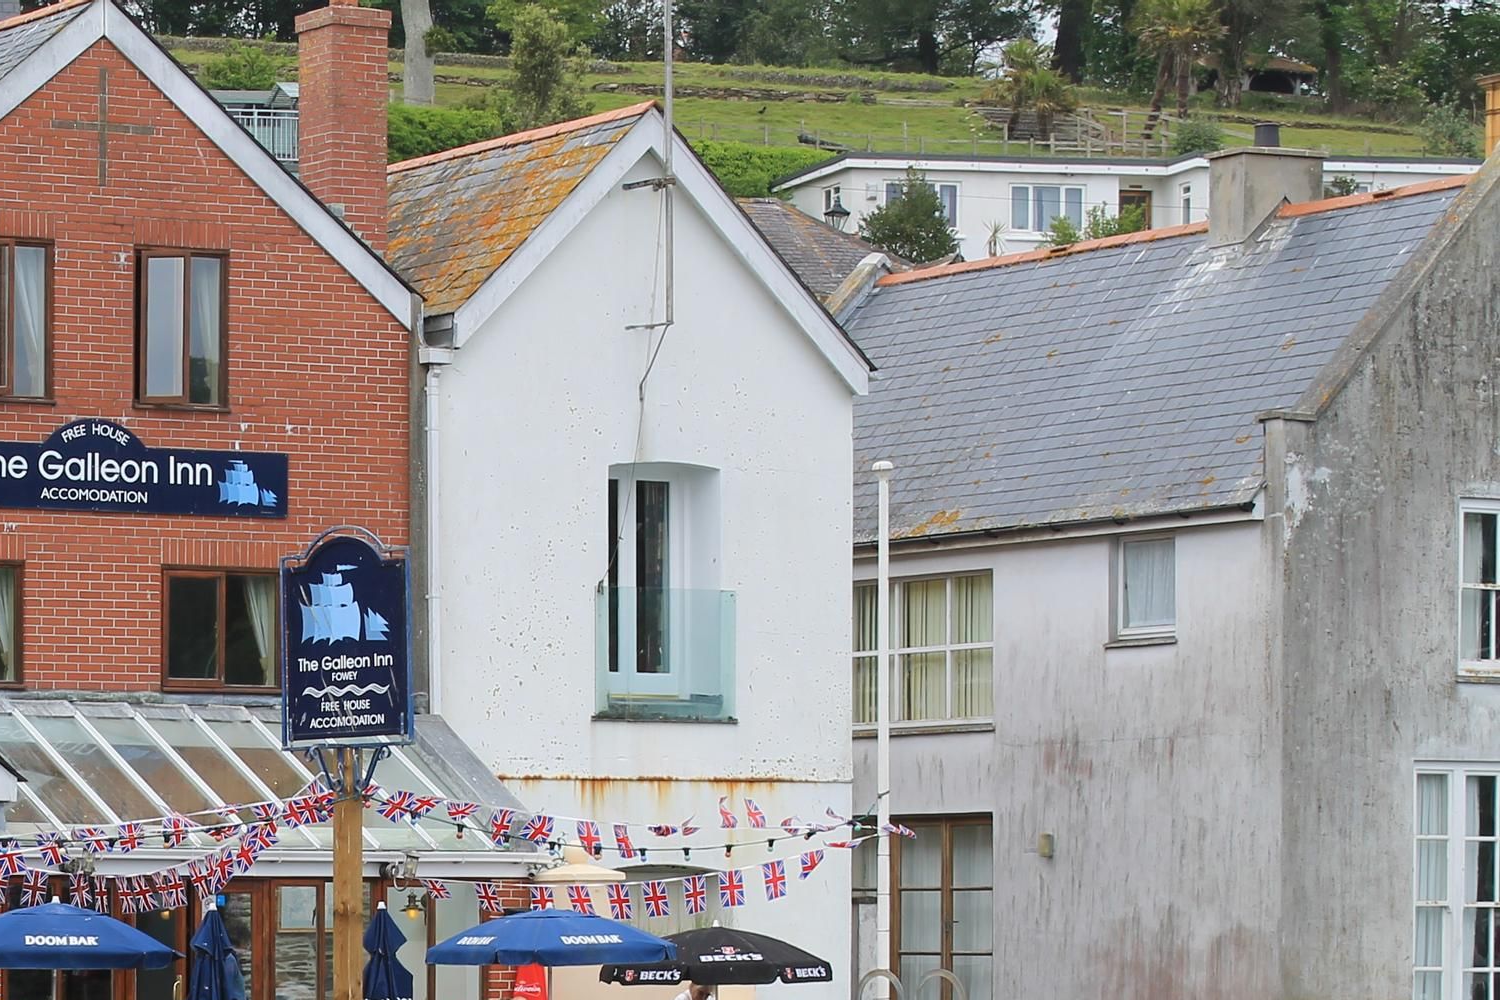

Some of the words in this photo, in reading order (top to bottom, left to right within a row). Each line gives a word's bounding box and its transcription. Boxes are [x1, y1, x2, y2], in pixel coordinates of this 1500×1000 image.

[61, 424, 87, 443] FREE
[92, 424, 130, 446] HOUSE
[37, 449, 160, 485] Galleon
[169, 455, 214, 487] Inn
[40, 487, 148, 504] ACCOMODATION
[298, 657, 319, 672] The
[321, 653, 371, 671] Galleon
[373, 653, 393, 667] Inn
[331, 671, 358, 682] FOWEY
[320, 700, 340, 712] FREE
[343, 699, 371, 711] HOUSE
[309, 713, 385, 729] ACCOMODATION
[24, 935, 67, 946] DOOM
[69, 936, 99, 946] BAR
[560, 935, 598, 945] DOOM
[599, 934, 622, 944] BAR
[699, 952, 764, 963] BECK'S
[639, 968, 682, 981] BECK'S
[795, 965, 827, 978] BECK'S
